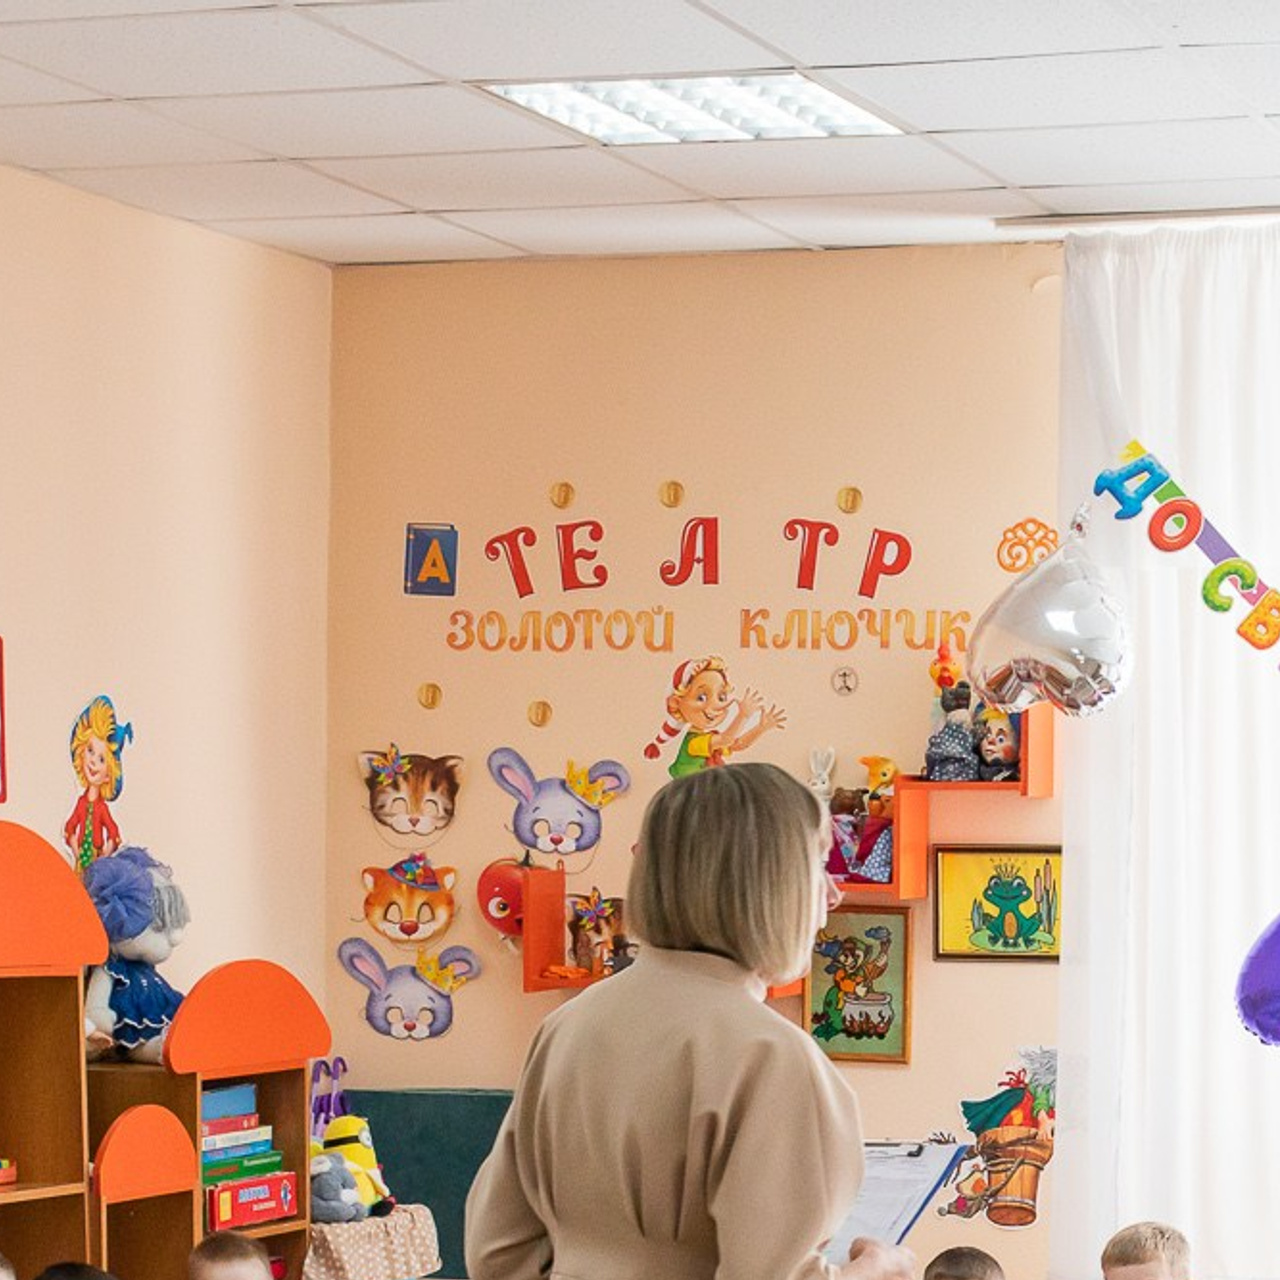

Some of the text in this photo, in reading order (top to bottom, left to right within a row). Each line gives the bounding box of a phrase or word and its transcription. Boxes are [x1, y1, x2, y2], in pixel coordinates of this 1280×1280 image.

[1093, 453, 1203, 553] ДО
[446, 605, 971, 653] ЗОЛОТОЙ КЛЮЧИК
